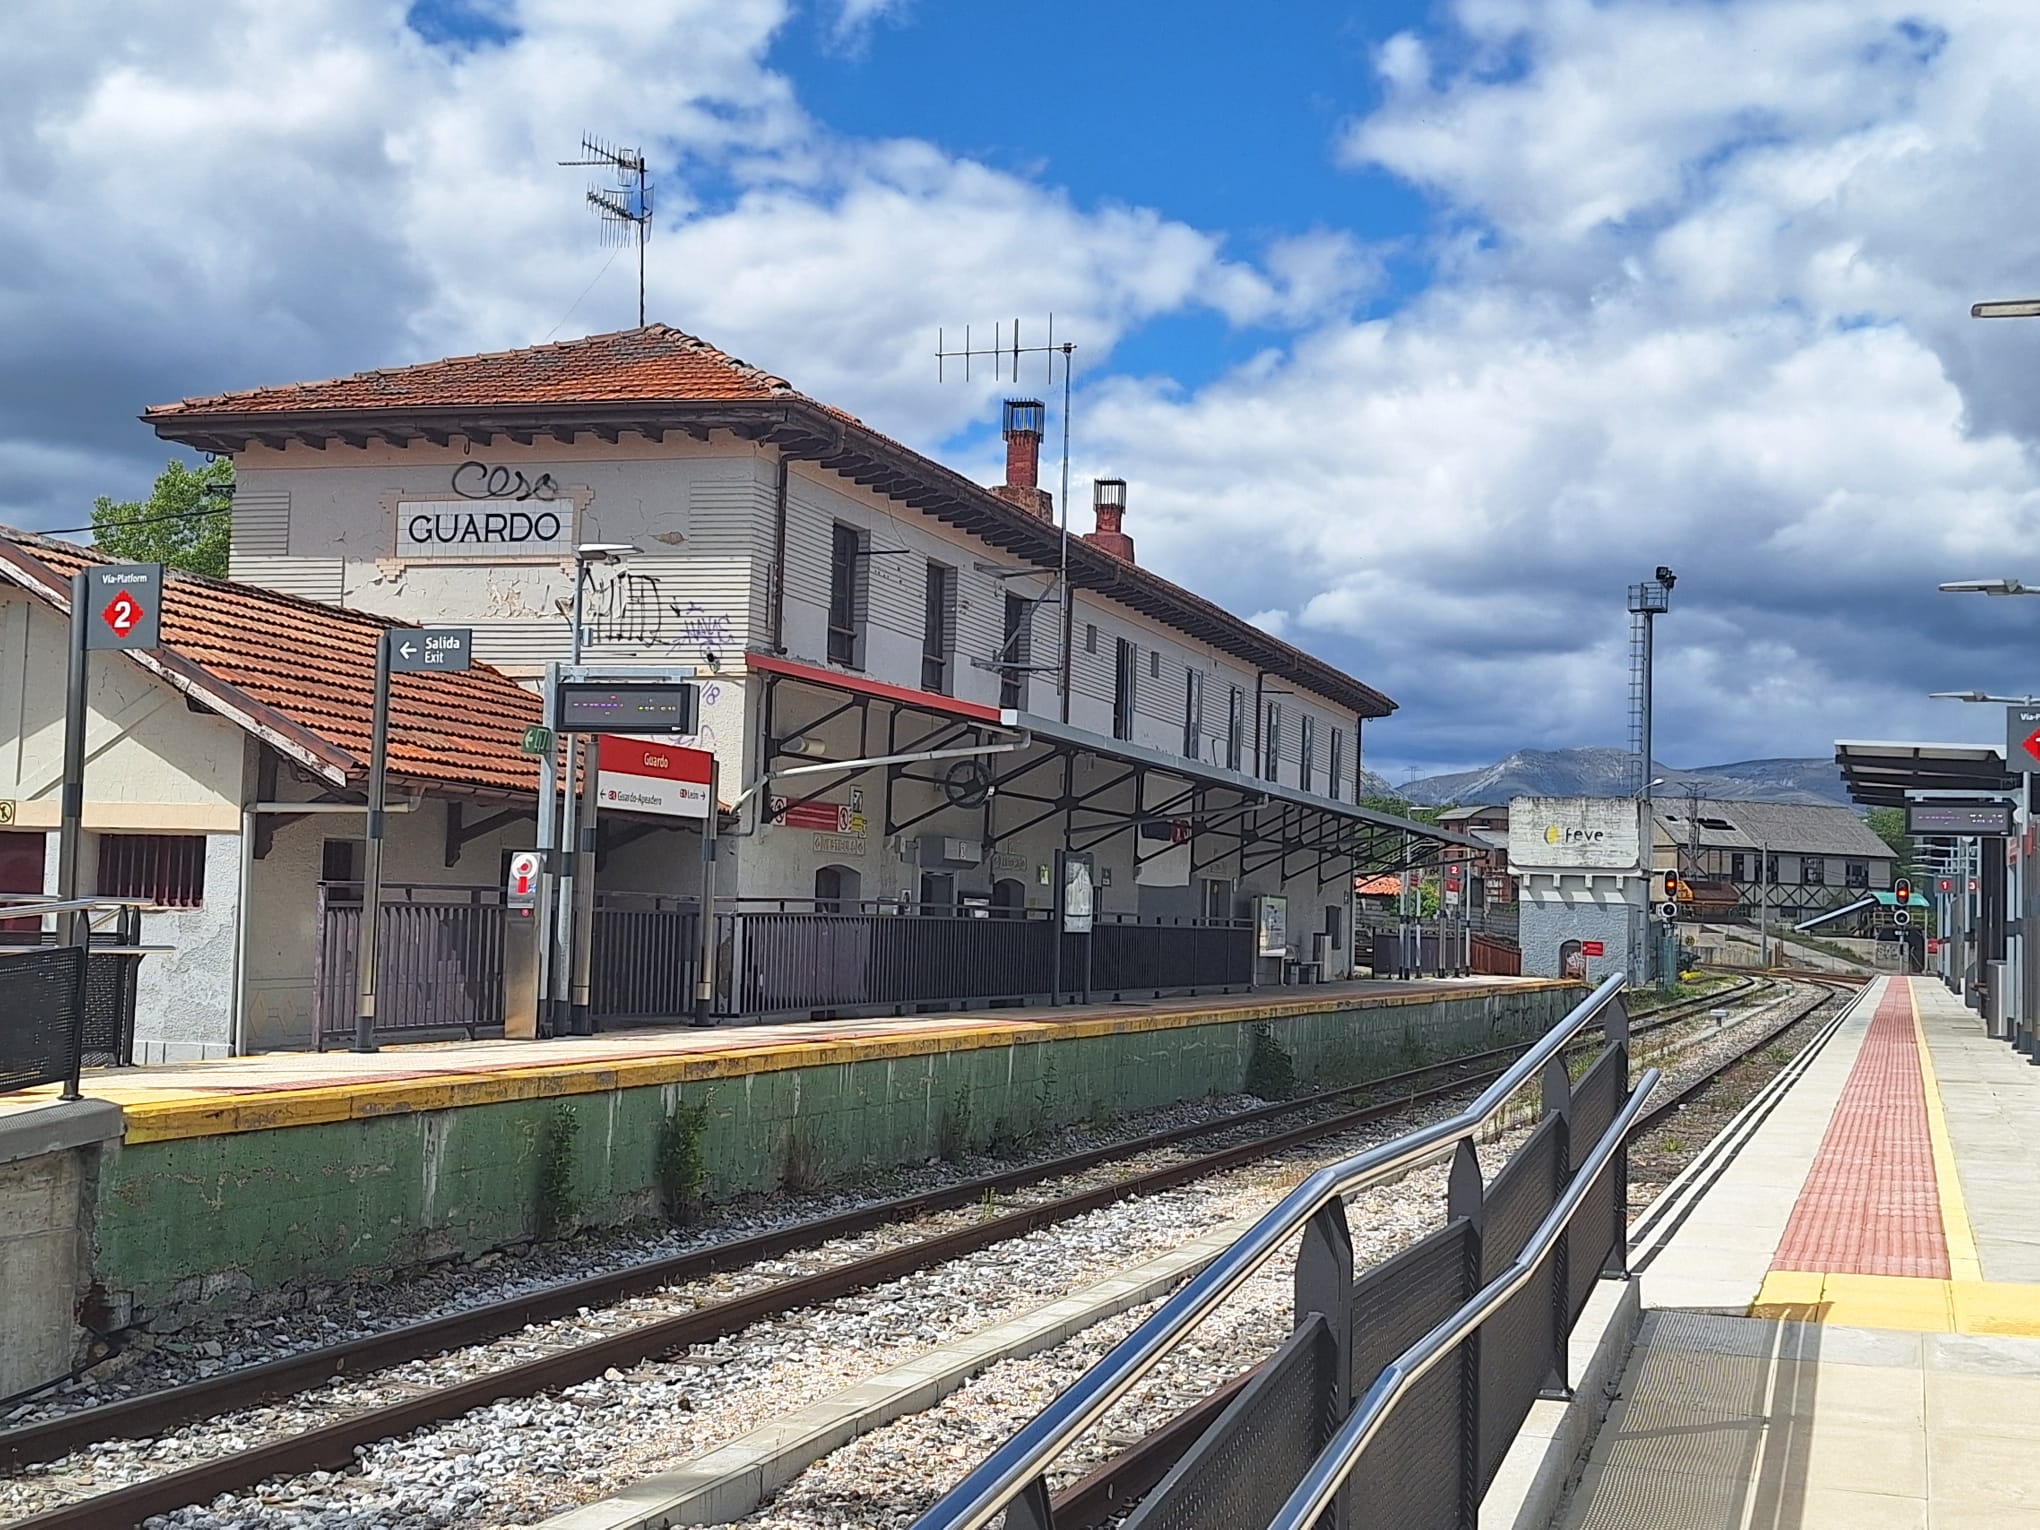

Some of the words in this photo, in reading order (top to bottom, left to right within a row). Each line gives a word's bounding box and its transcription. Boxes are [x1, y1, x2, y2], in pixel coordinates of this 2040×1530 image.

[408, 512, 561, 543] GUARDO
[114, 601, 131, 628] 2
[425, 636, 460, 649] Salida
[424, 651, 444, 664] Exit
[643, 752, 669, 769] Guardo
[1451, 865, 1458, 874] 2
[1942, 881, 1948, 890] 1
[1969, 881, 1976, 890] 3
